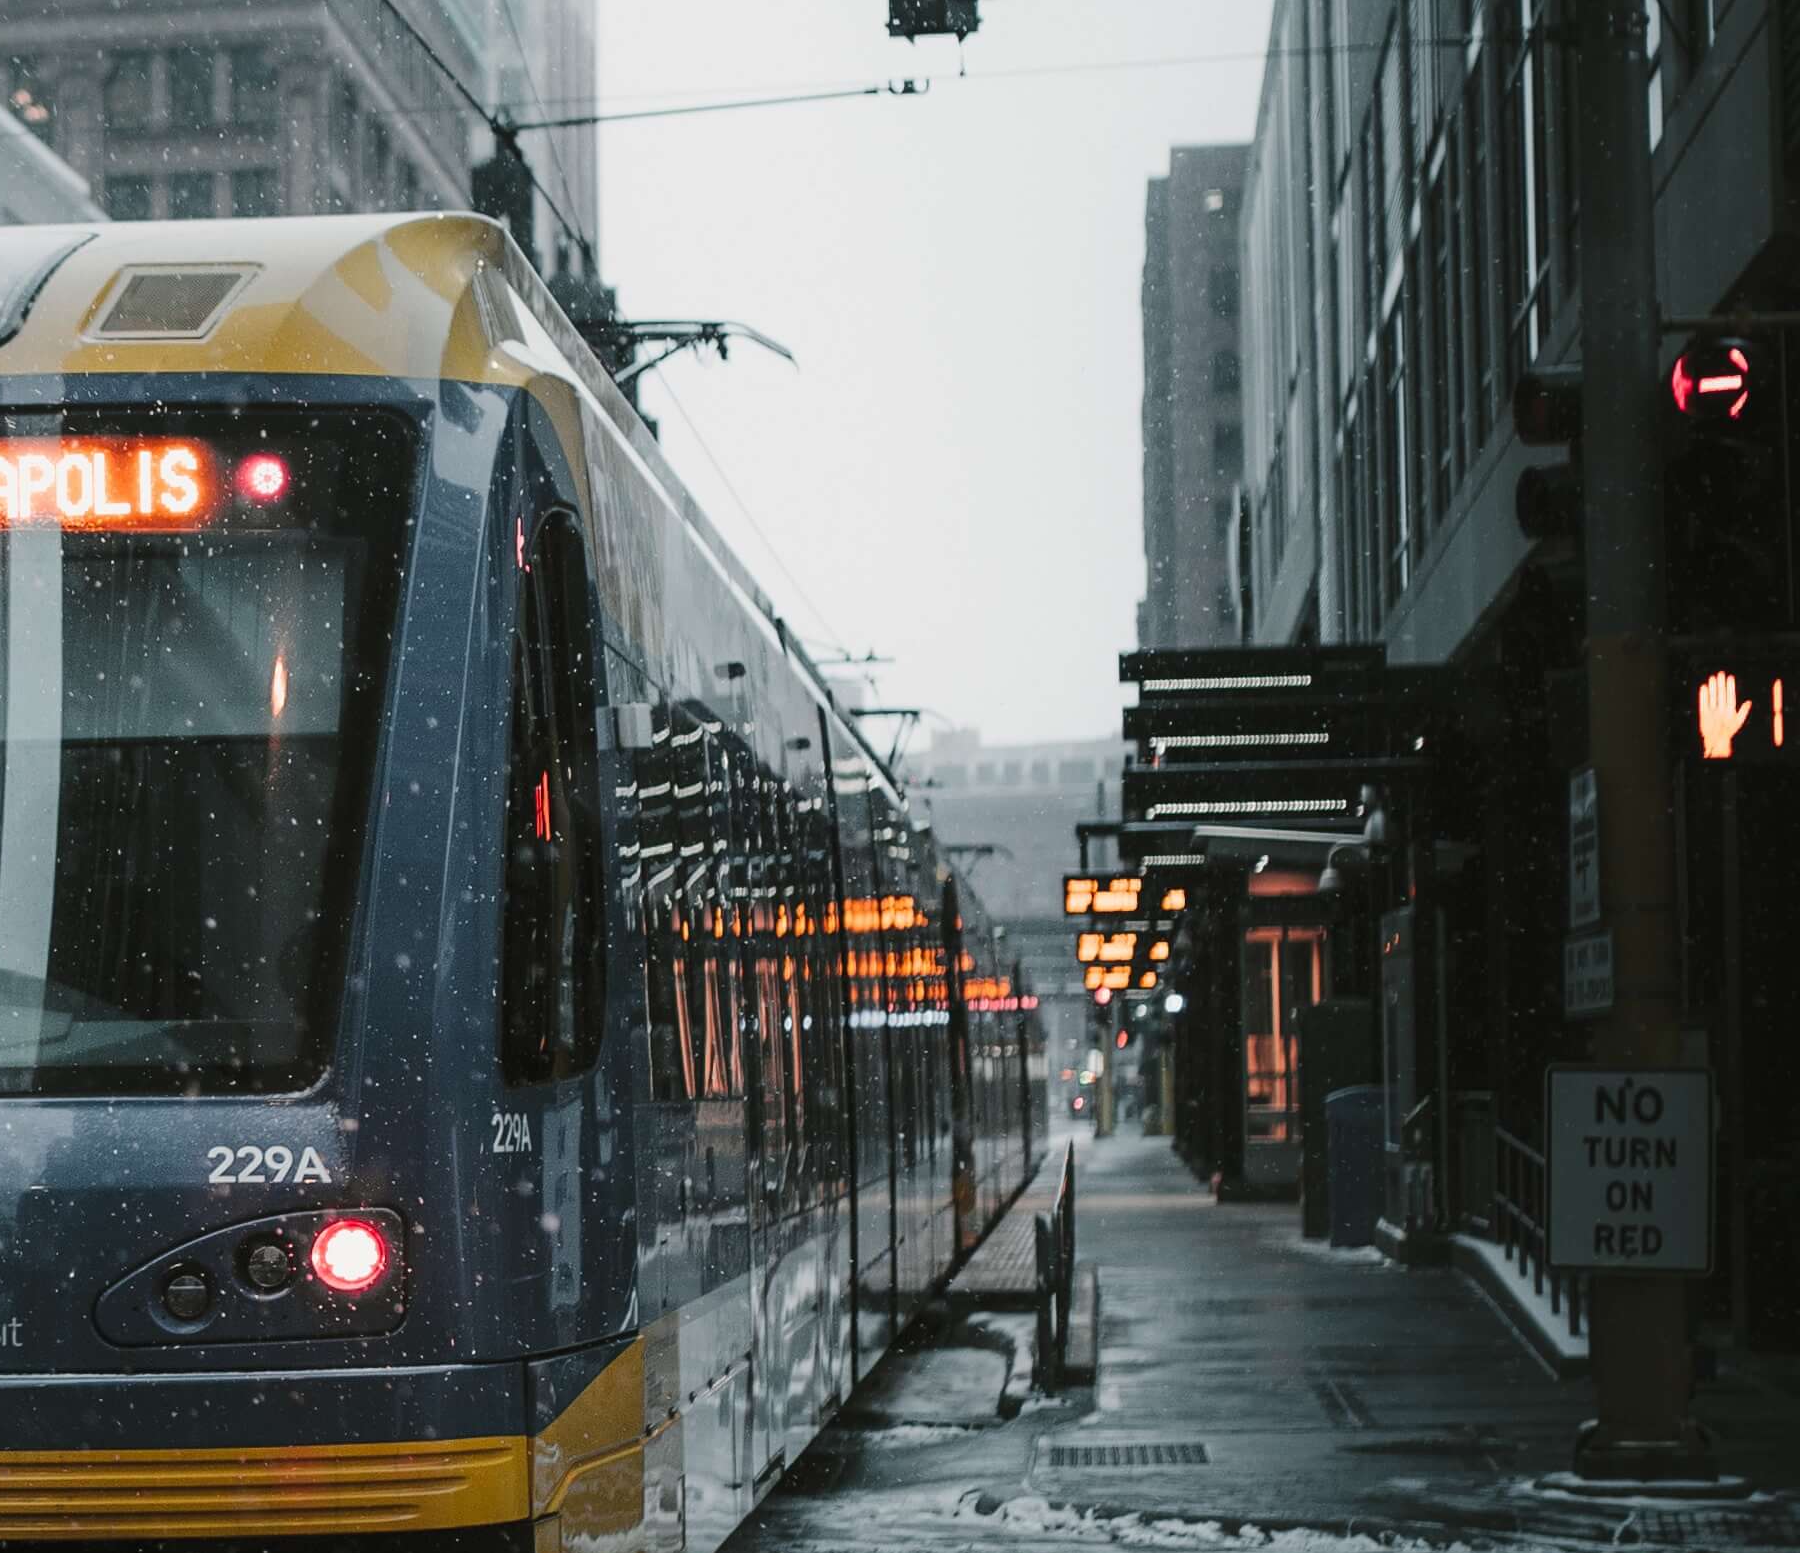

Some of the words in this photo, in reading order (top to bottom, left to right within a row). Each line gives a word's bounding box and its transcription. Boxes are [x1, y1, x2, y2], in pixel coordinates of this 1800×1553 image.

[1594, 1084, 1665, 1127] NO
[492, 1113, 532, 1153] 229A
[207, 1146, 332, 1184] 229A
[1583, 1136, 1678, 1170] TURN
[1605, 1180, 1654, 1214] ON
[1593, 1224, 1663, 1258] RED
